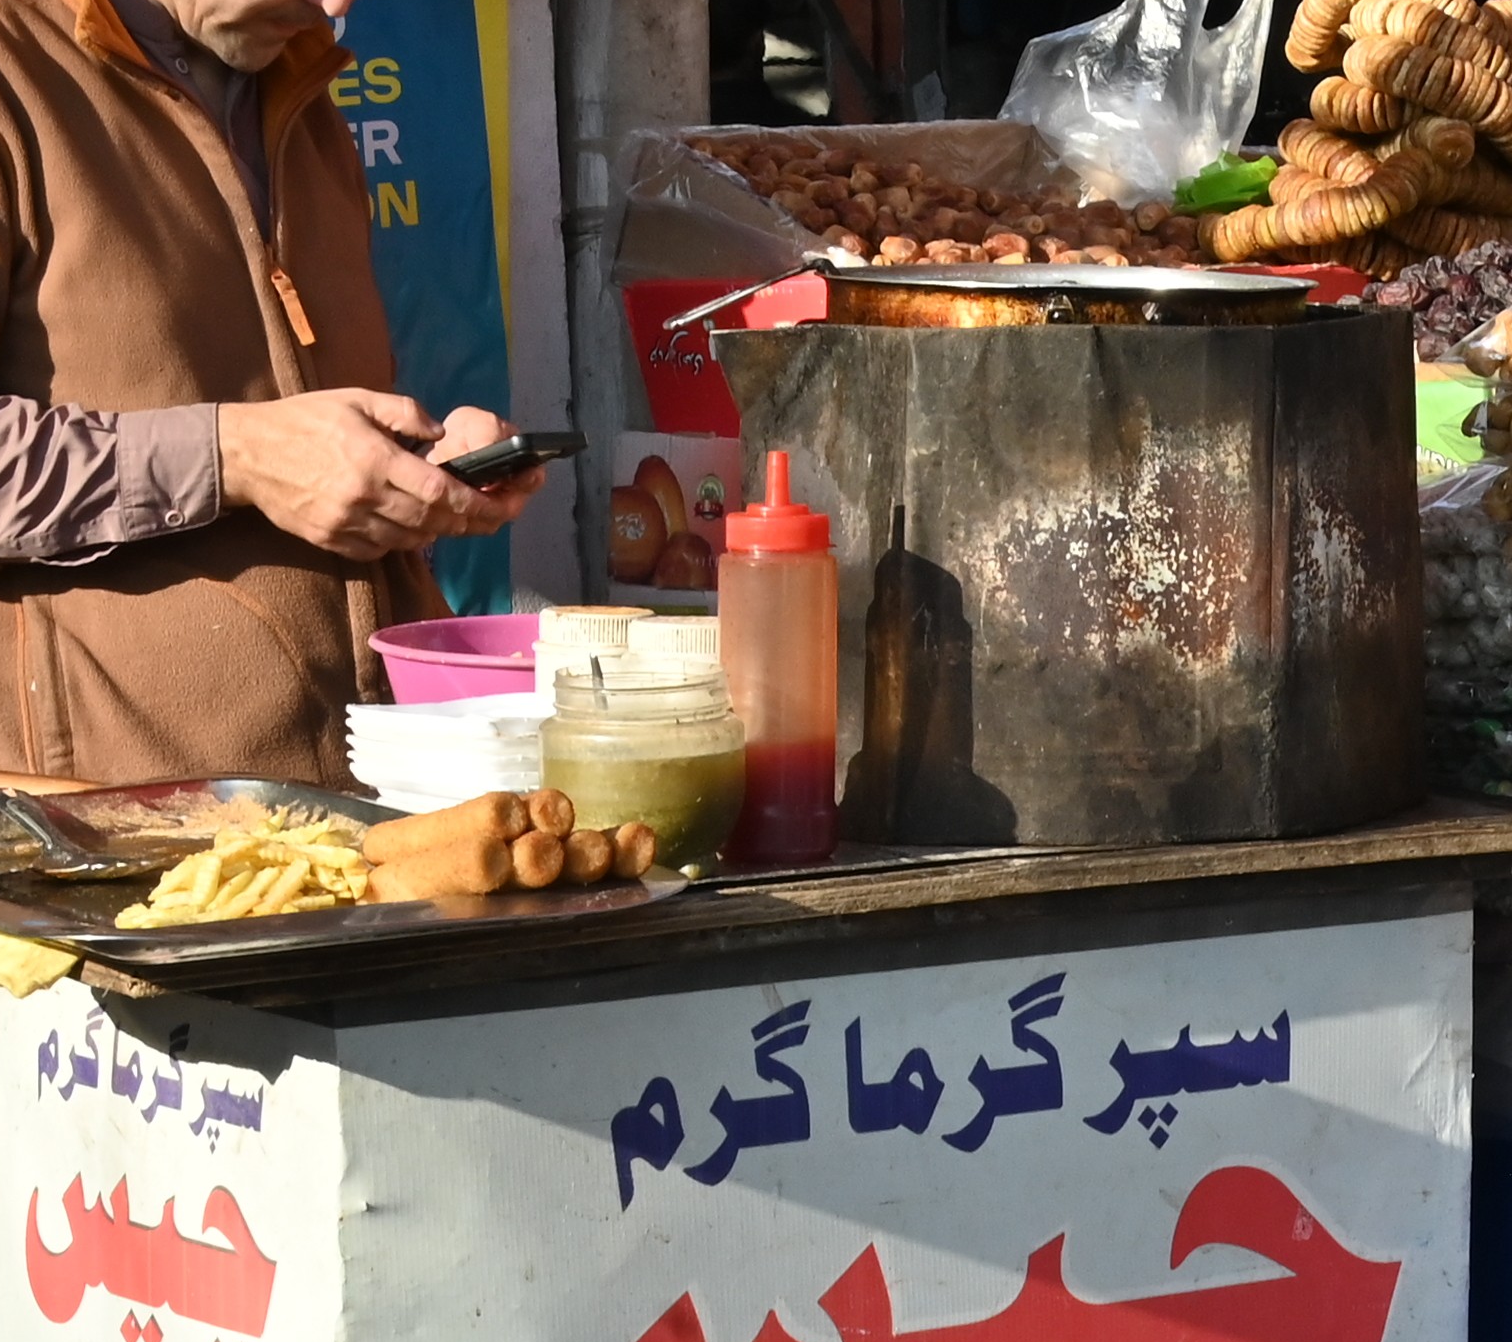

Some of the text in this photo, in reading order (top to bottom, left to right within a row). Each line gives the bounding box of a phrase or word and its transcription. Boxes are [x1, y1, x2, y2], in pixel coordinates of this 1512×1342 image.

[37, 1003, 265, 1155] سپر گرما گرم
[609, 972, 1292, 1213] سپر گرما گرم
